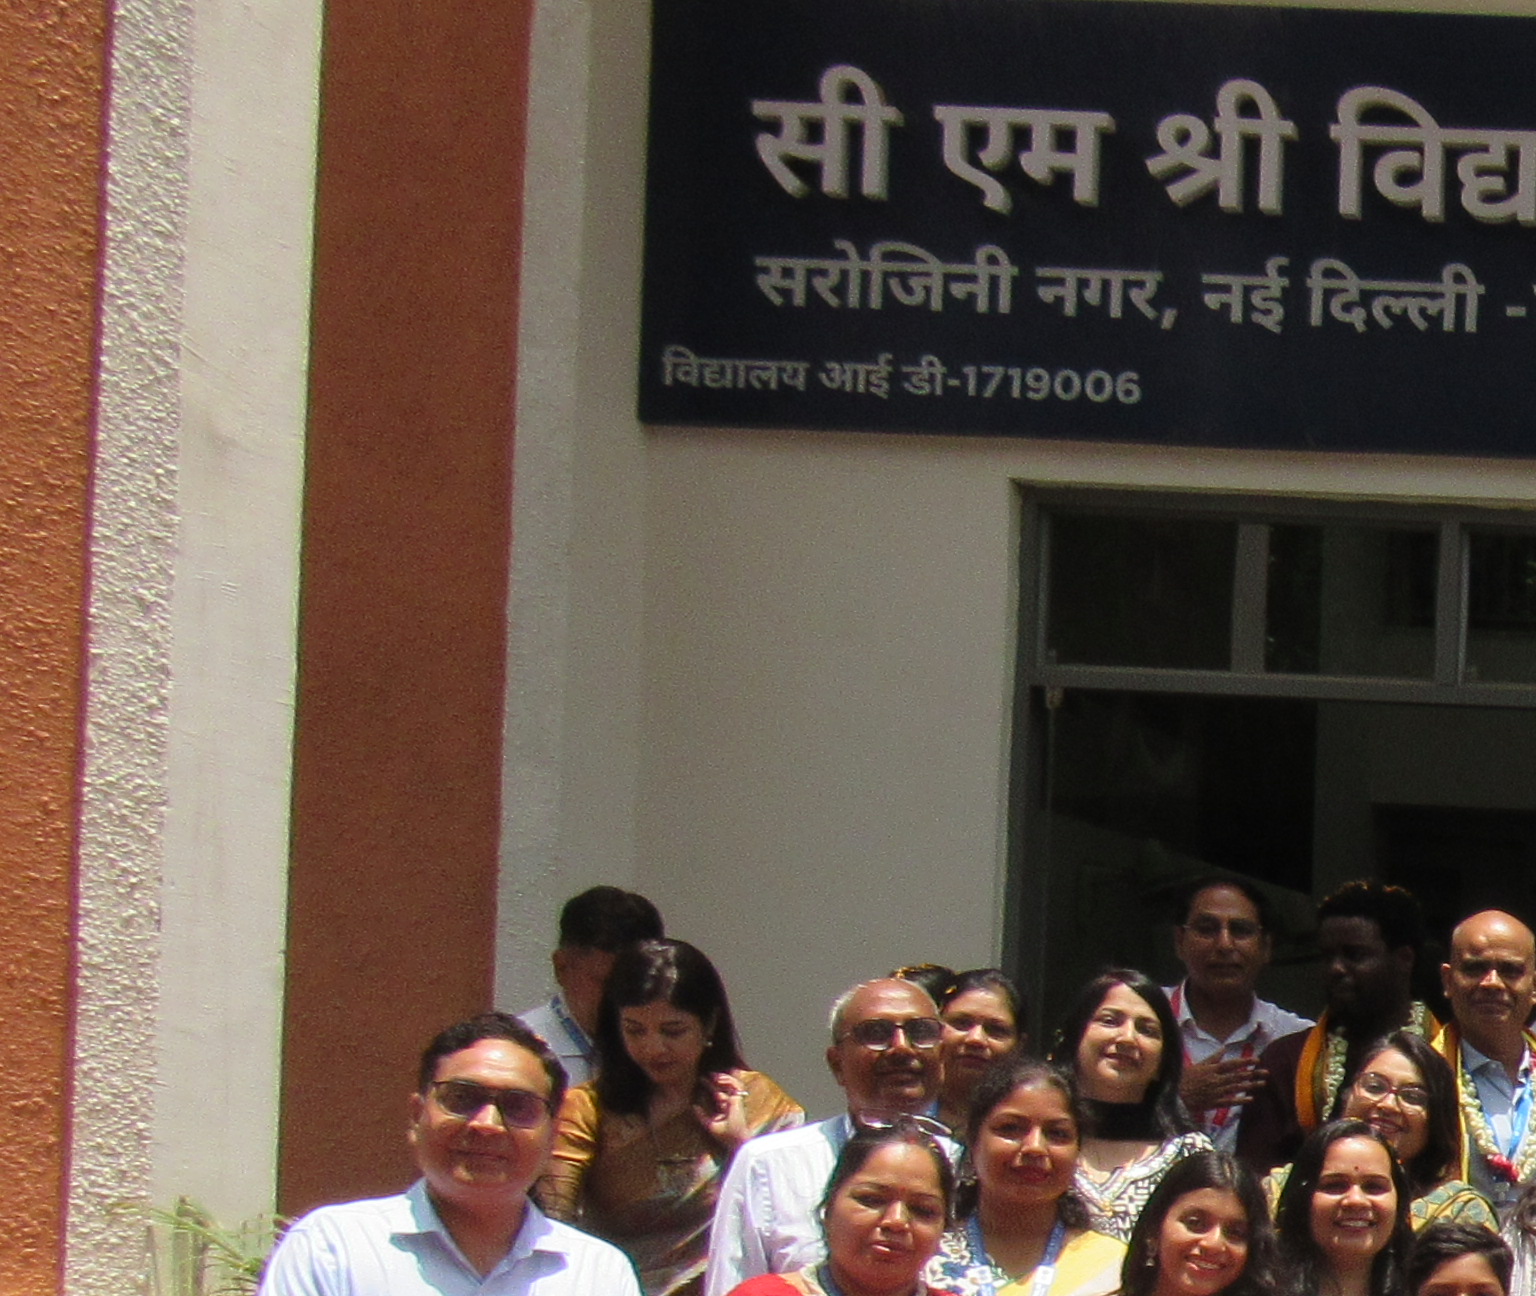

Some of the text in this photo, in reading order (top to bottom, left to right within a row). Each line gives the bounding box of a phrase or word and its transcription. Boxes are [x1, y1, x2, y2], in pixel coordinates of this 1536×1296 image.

[752, 64, 901, 197] सी
[933, 104, 1112, 215] एम
[1145, 78, 1297, 219] श्री
[754, 240, 1017, 315] सरोजिनी
[1036, 268, 1181, 330] नगर,
[1202, 258, 1290, 334] नई
[1306, 258, 1485, 335] दिल्ली
[661, 345, 1143, 405] विद्यालय आई डी-1719006
